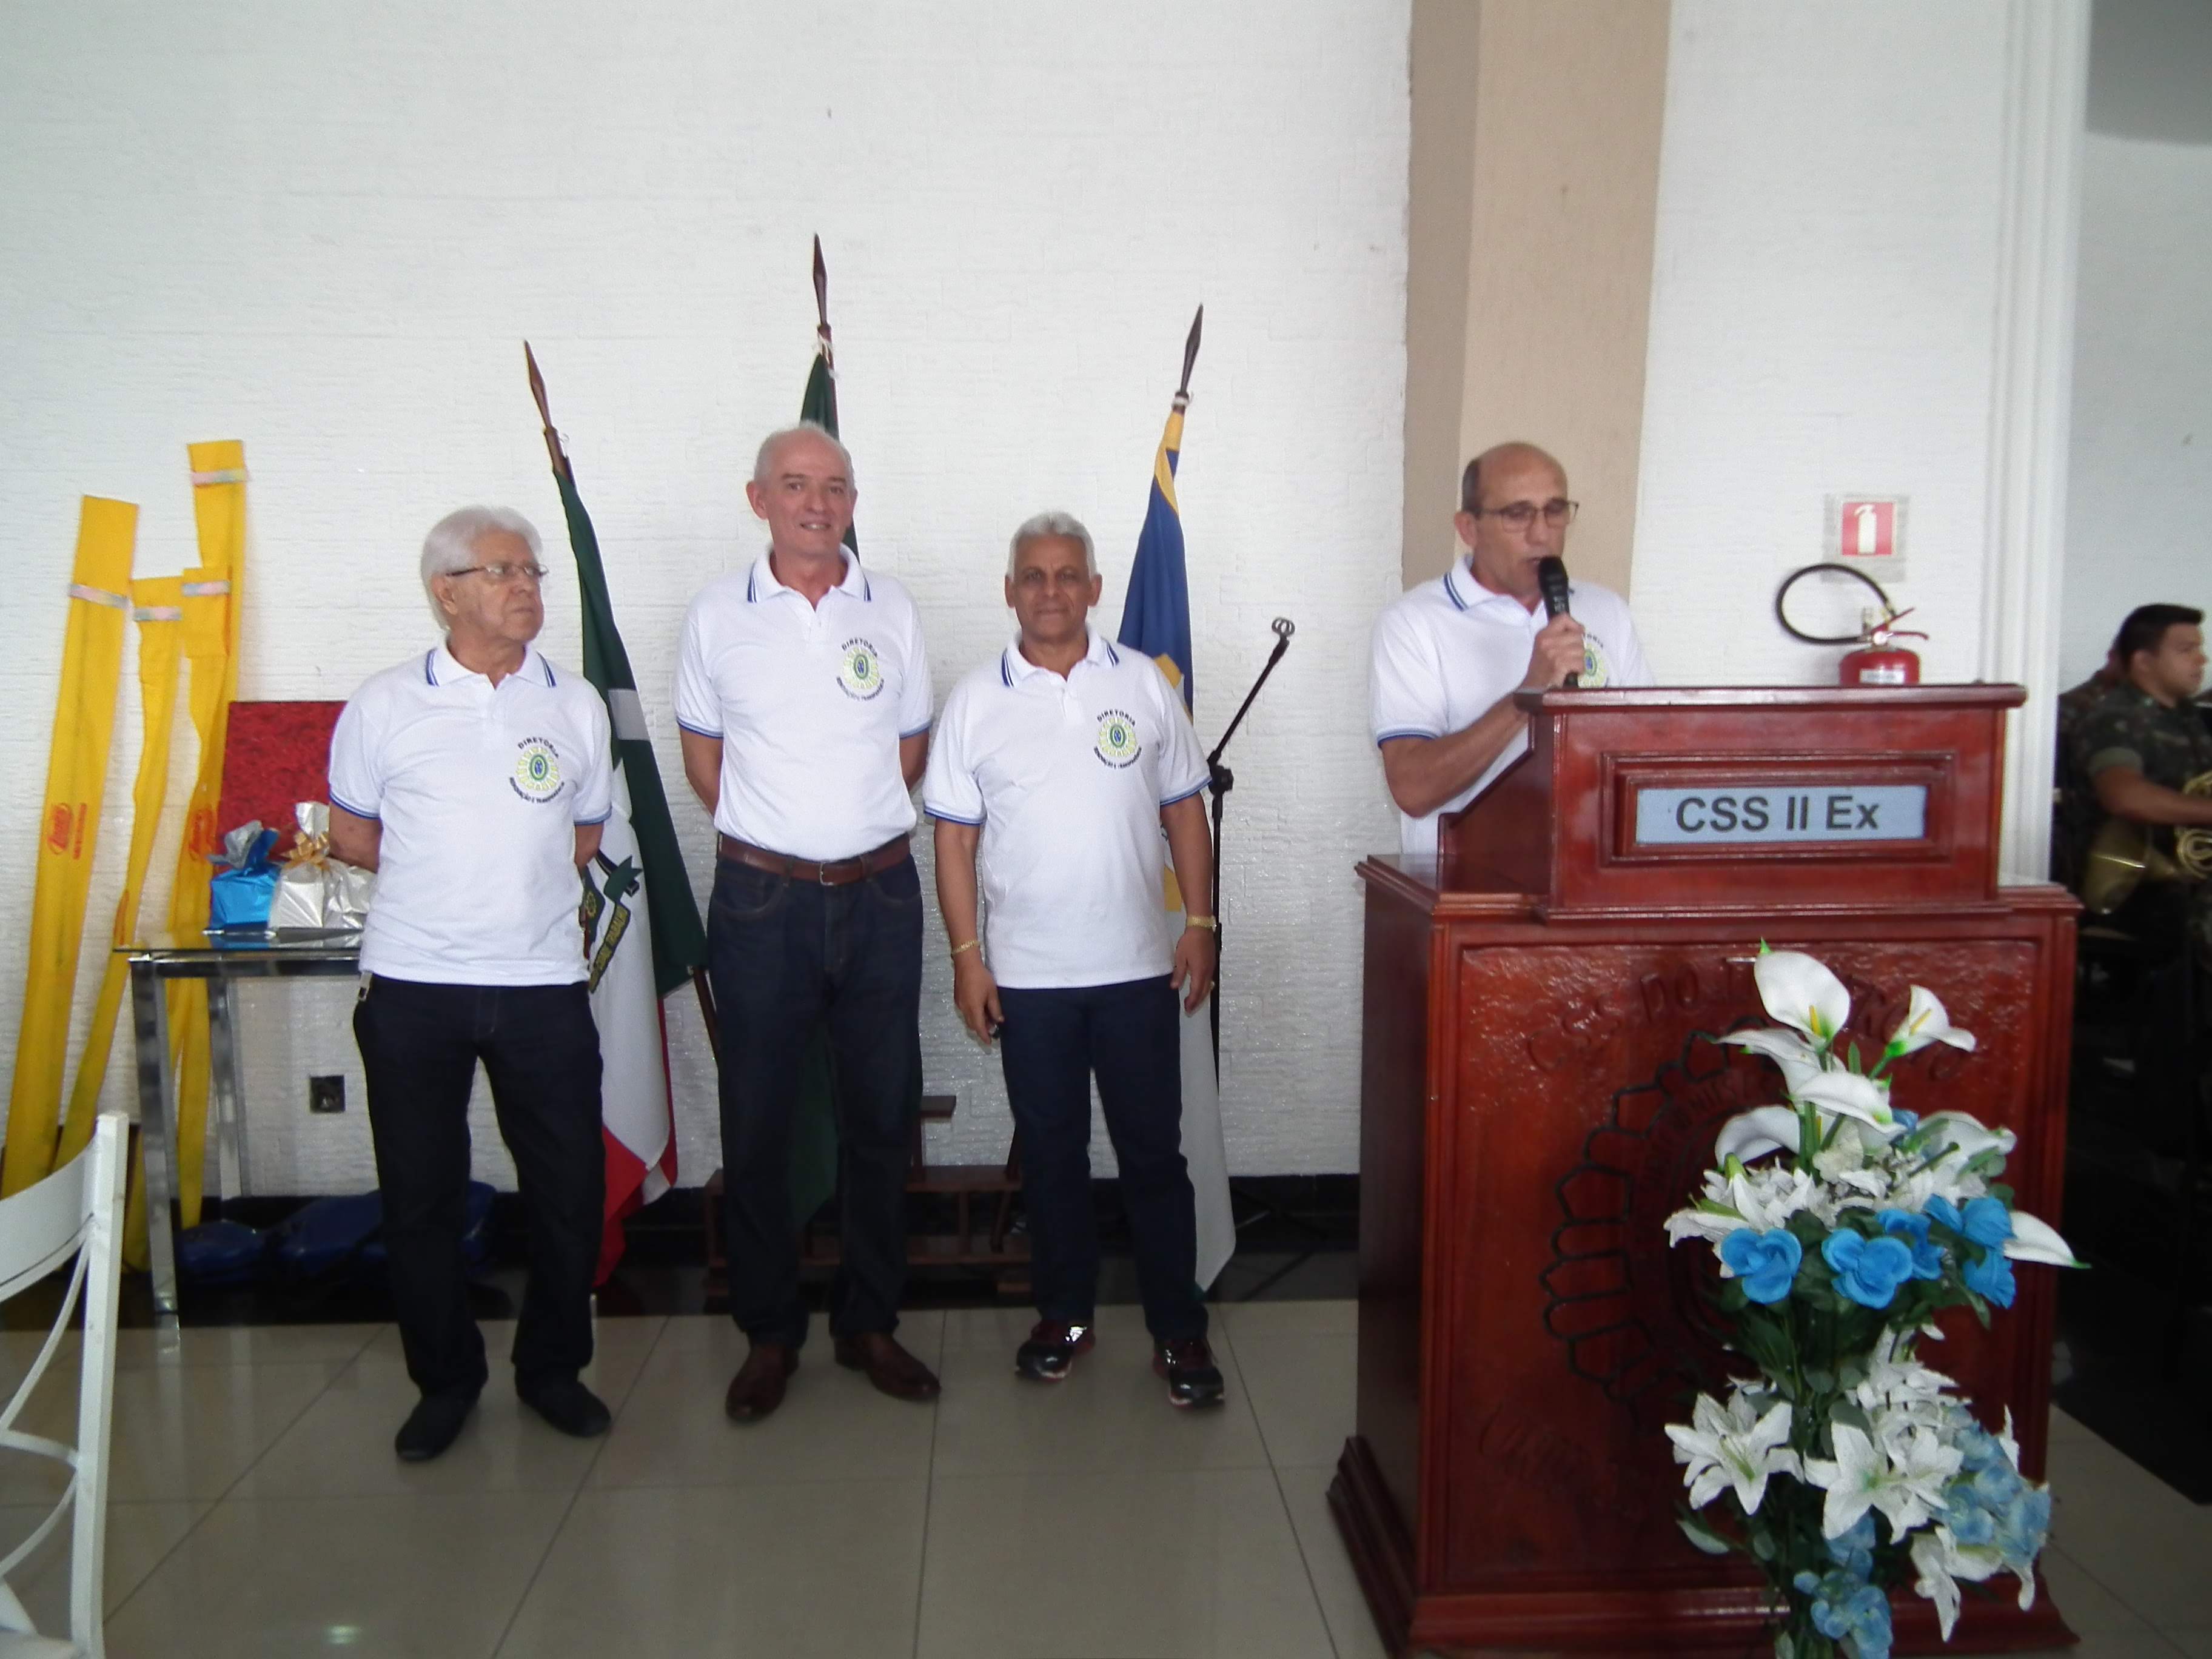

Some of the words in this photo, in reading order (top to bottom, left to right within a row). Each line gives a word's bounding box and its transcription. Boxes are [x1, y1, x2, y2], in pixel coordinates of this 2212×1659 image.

[841, 637, 877, 658] DIRETORIA
[1097, 709, 1135, 727] DIRETORIA
[518, 737, 558, 758] DIRETORIA
[1675, 796, 1769, 833] CSS
[1786, 796, 1809, 831] II
[1825, 795, 1880, 831] Ex
